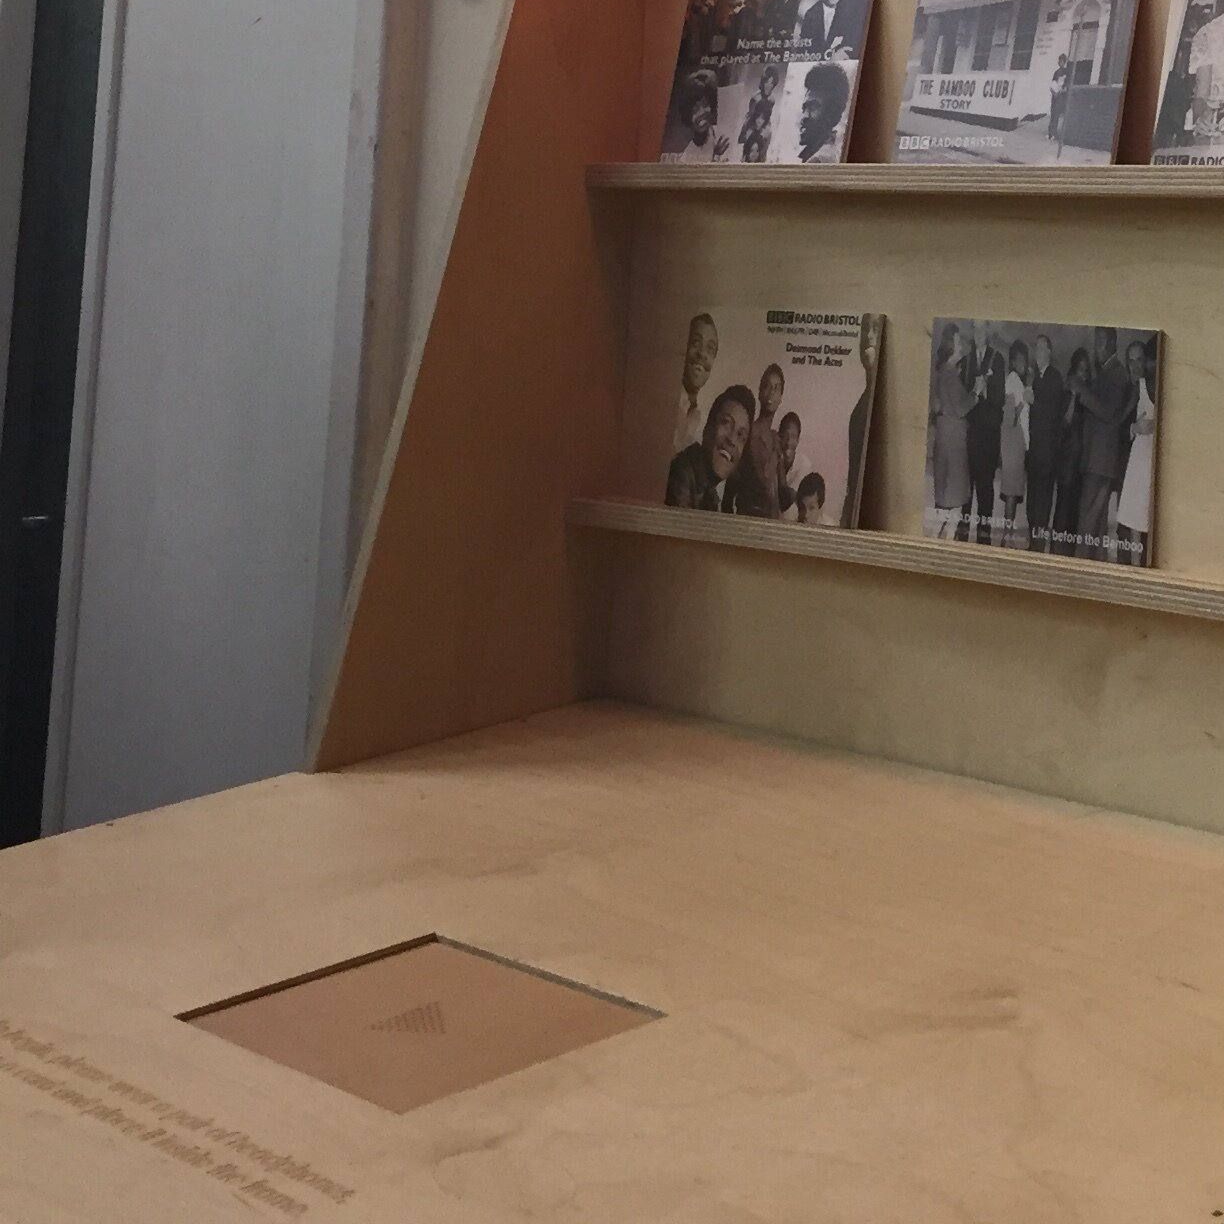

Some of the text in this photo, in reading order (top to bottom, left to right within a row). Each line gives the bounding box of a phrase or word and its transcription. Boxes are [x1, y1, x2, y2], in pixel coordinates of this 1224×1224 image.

[737, 38, 764, 49] Name
[766, 38, 782, 49] the
[764, 51, 781, 63] The
[783, 51, 822, 62] Bamboo
[919, 79, 935, 96] THE
[939, 80, 976, 97] BAMBOO
[940, 99, 971, 110] STORY
[786, 342, 853, 356] Desmond Dekker
[792, 356, 806, 366] and
[808, 356, 822, 367] The
[1031, 526, 1144, 554] Life before the Bamboo
